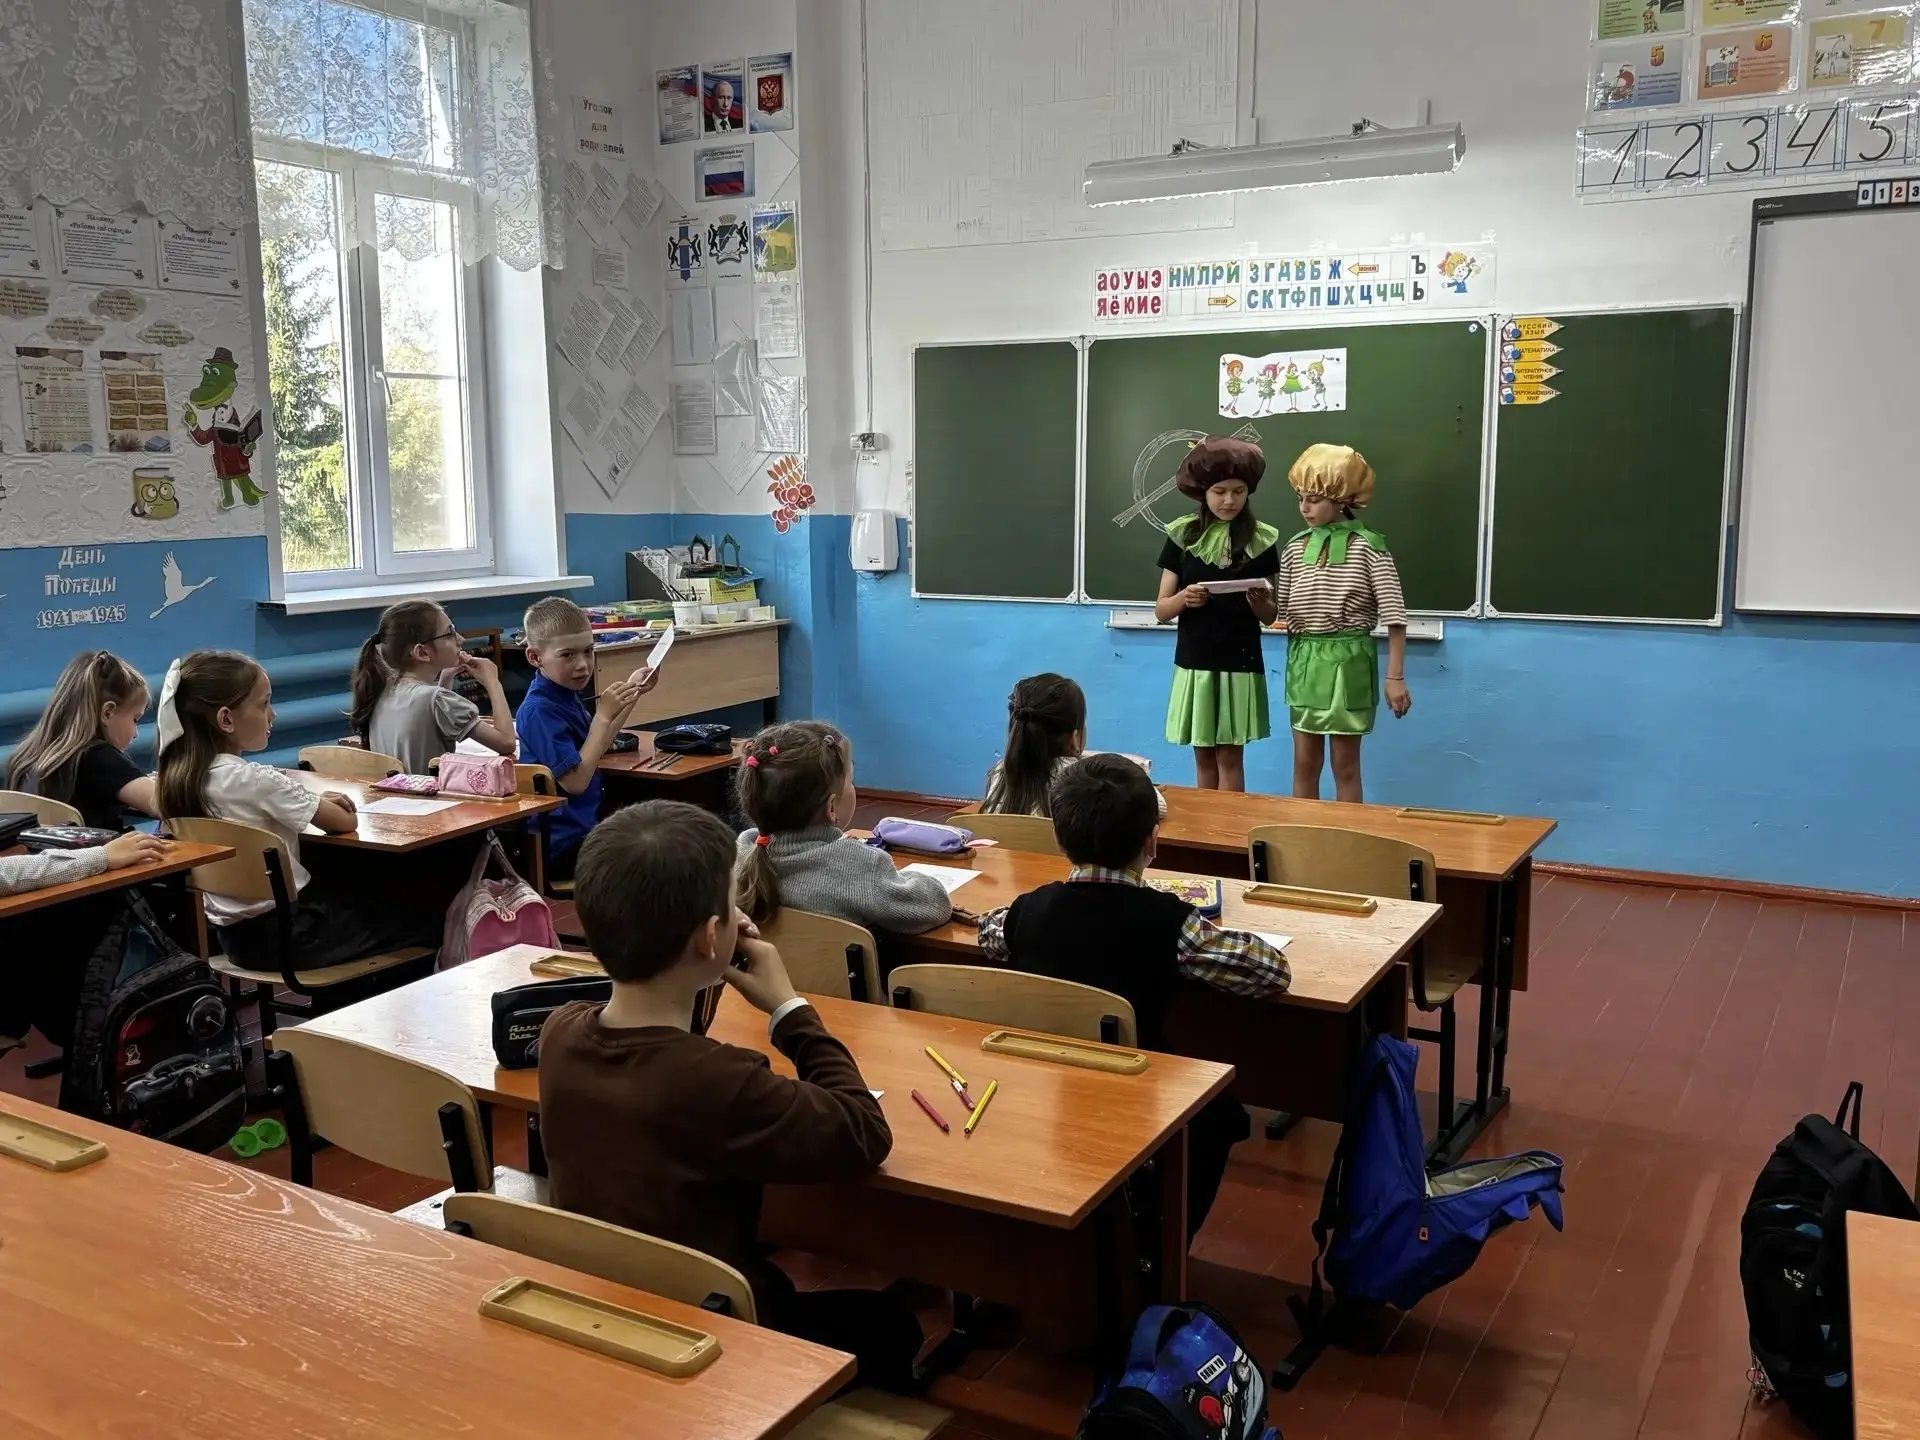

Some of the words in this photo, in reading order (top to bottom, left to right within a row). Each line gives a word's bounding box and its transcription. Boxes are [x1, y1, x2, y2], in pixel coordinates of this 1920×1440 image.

[1868, 19, 1886, 40] 7
[1754, 31, 1773, 52] 6
[1651, 44, 1665, 67] 5
[1612, 128, 1640, 185] 1
[1664, 121, 1703, 180] 2
[1724, 115, 1769, 173] 3
[1786, 105, 1840, 168] 4
[1861, 189, 1869, 200] 0
[1879, 188, 1885, 199] 1
[1894, 187, 1903, 198] 2
[1911, 186, 1920, 197] 3
[1518, 322, 1553, 330] РУССКИЙ
[37, 609, 75, 628] 1941
[90, 604, 126, 624] 1945
[1200, 1363, 1218, 1381] SHUN
[1213, 1357, 1225, 1369] YU
